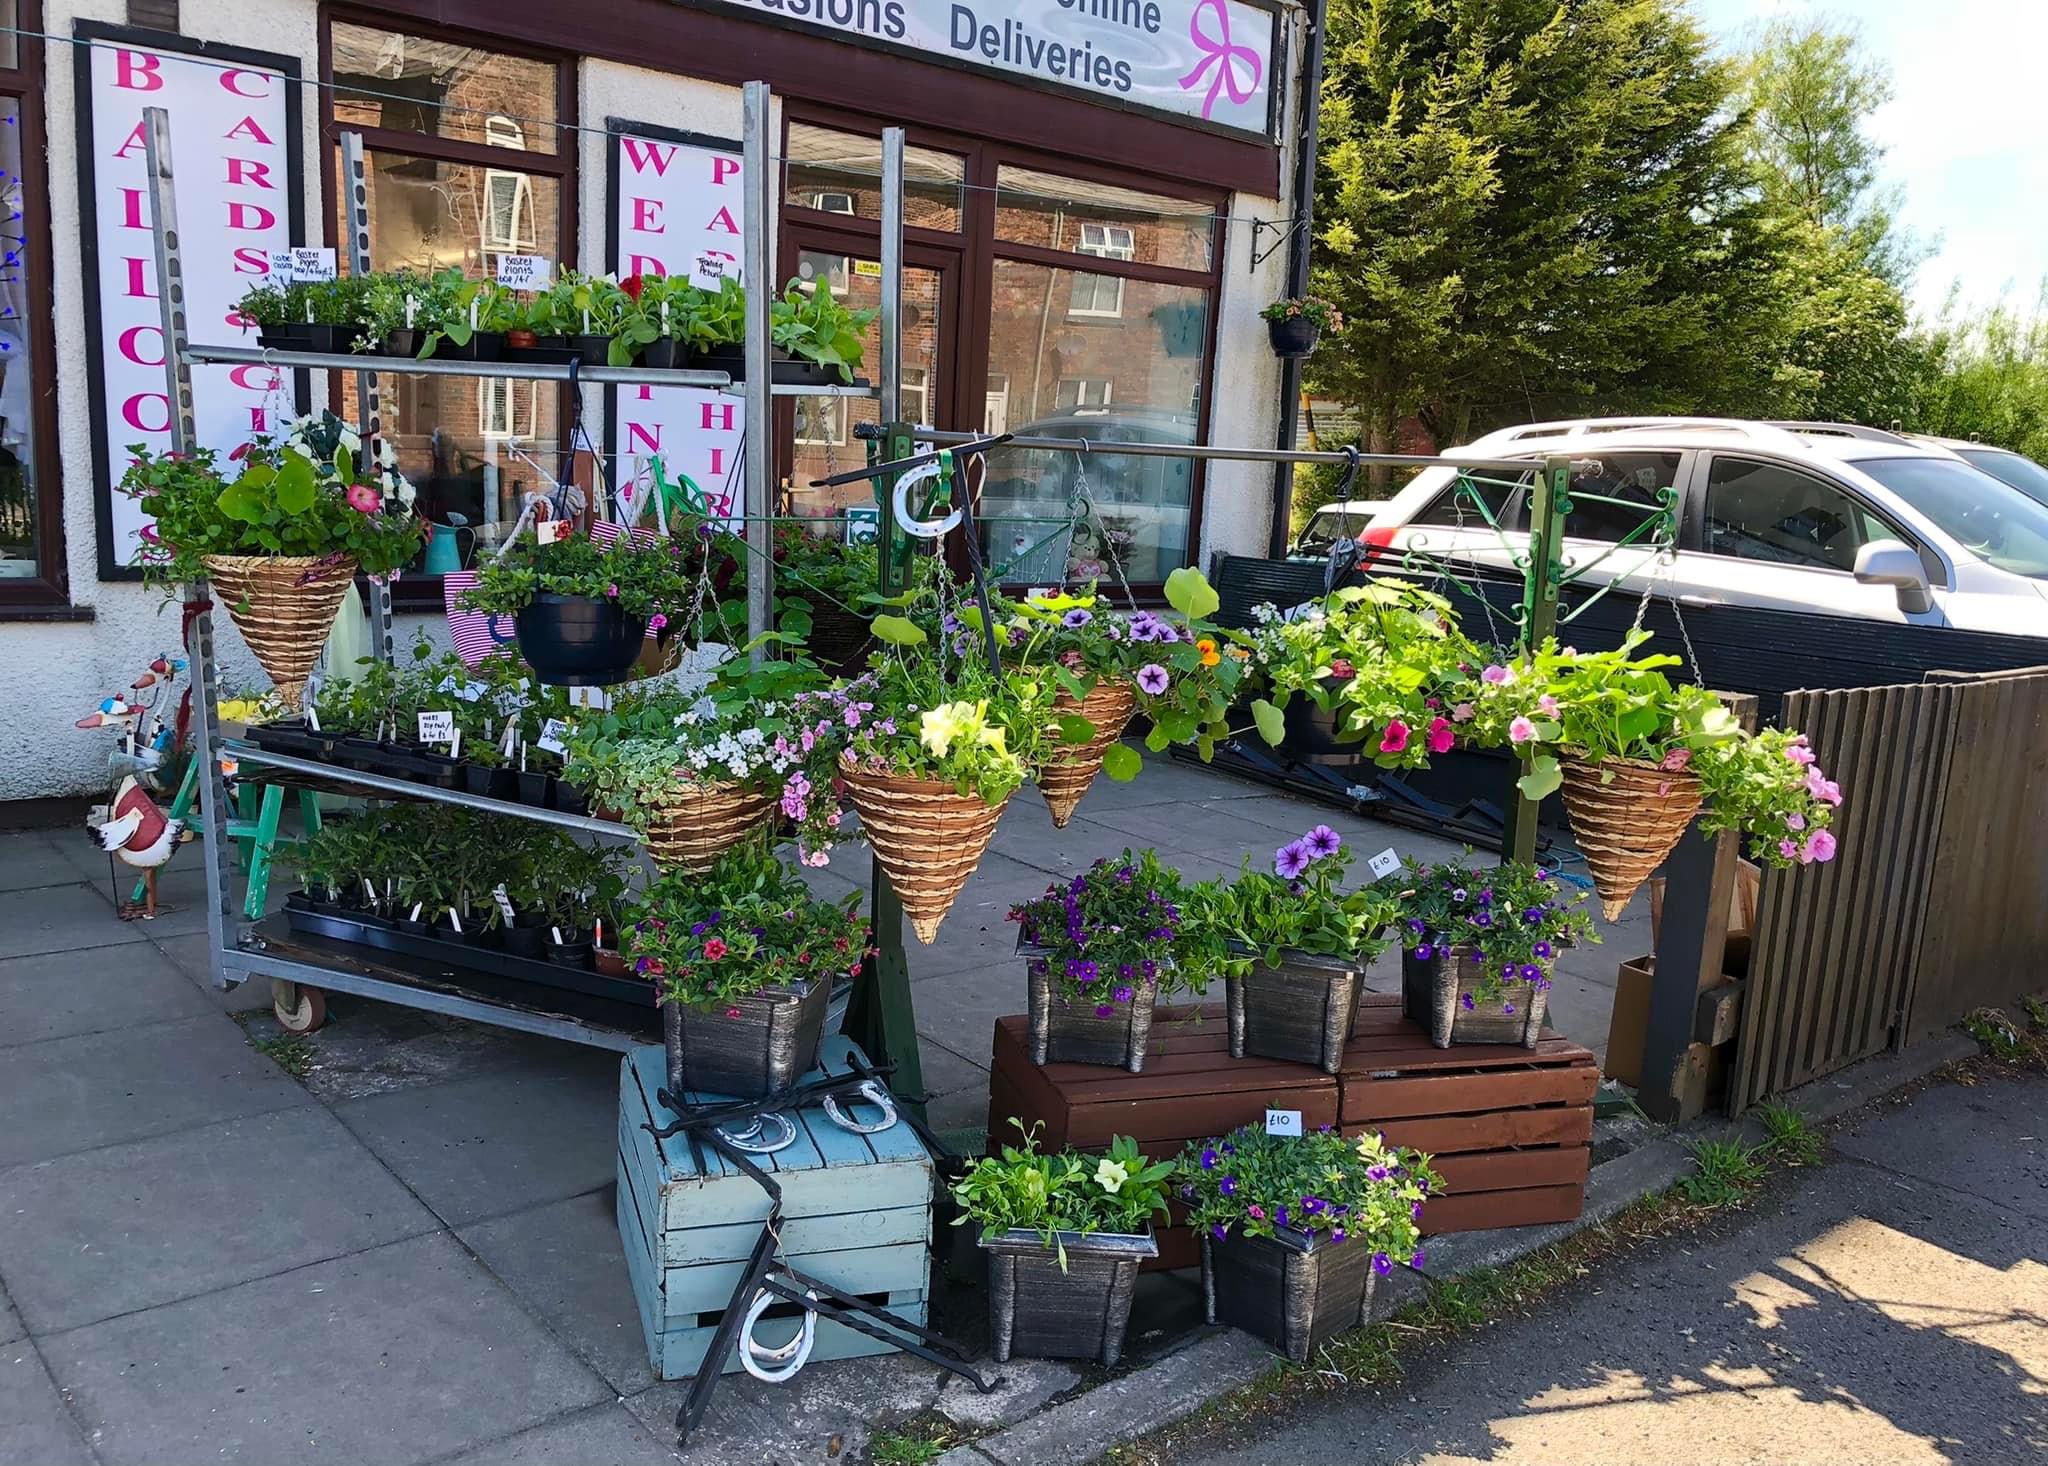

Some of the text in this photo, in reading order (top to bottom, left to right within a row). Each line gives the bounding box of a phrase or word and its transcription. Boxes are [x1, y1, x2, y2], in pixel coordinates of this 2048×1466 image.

[951, 3, 1132, 92] Deliveries
[218, 68, 278, 276] CARDS
[505, 256, 533, 266] Basket
[505, 265, 533, 275] Plants
[1373, 856, 1390, 870] £10
[1269, 1114, 1290, 1126] £10
